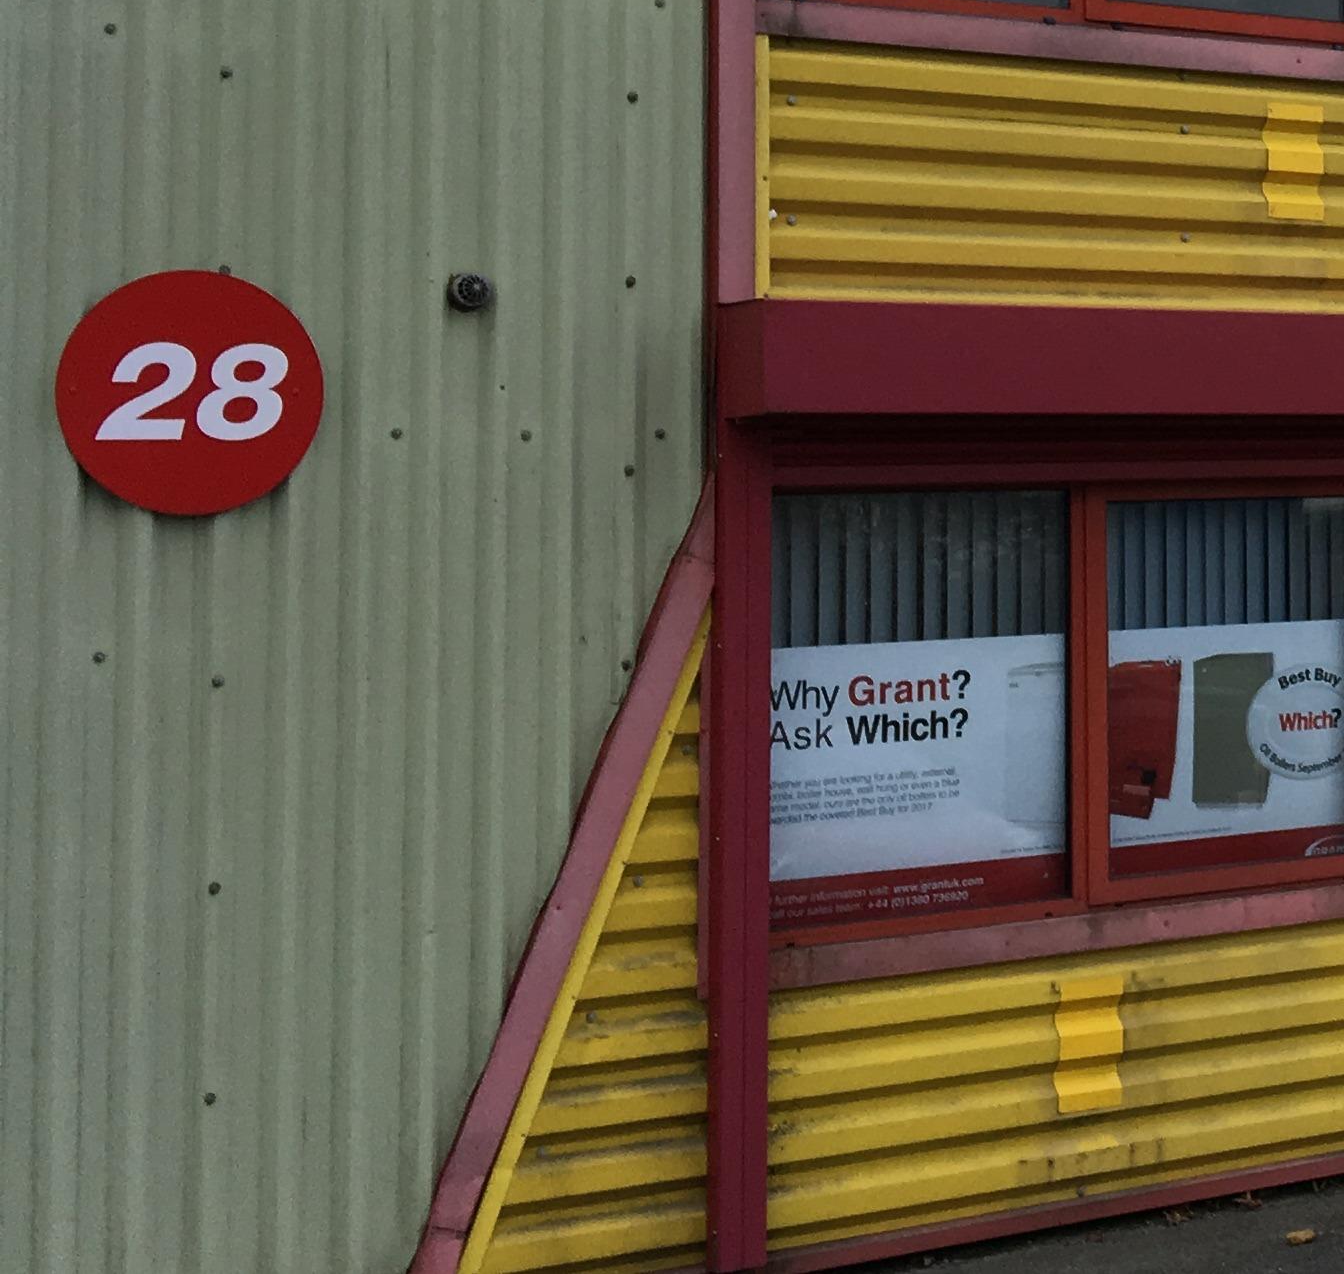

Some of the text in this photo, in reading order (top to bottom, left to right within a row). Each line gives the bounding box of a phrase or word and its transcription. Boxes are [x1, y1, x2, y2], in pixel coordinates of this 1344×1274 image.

[94, 341, 289, 442] 28
[1278, 667, 1342, 690] Best Buy
[770, 669, 971, 717] Why Grant?
[770, 707, 969, 751] Ask Which?
[1278, 707, 1342, 732] Which?
[893, 877, 985, 894] www.grantuk.com
[867, 898, 889, 910] +44
